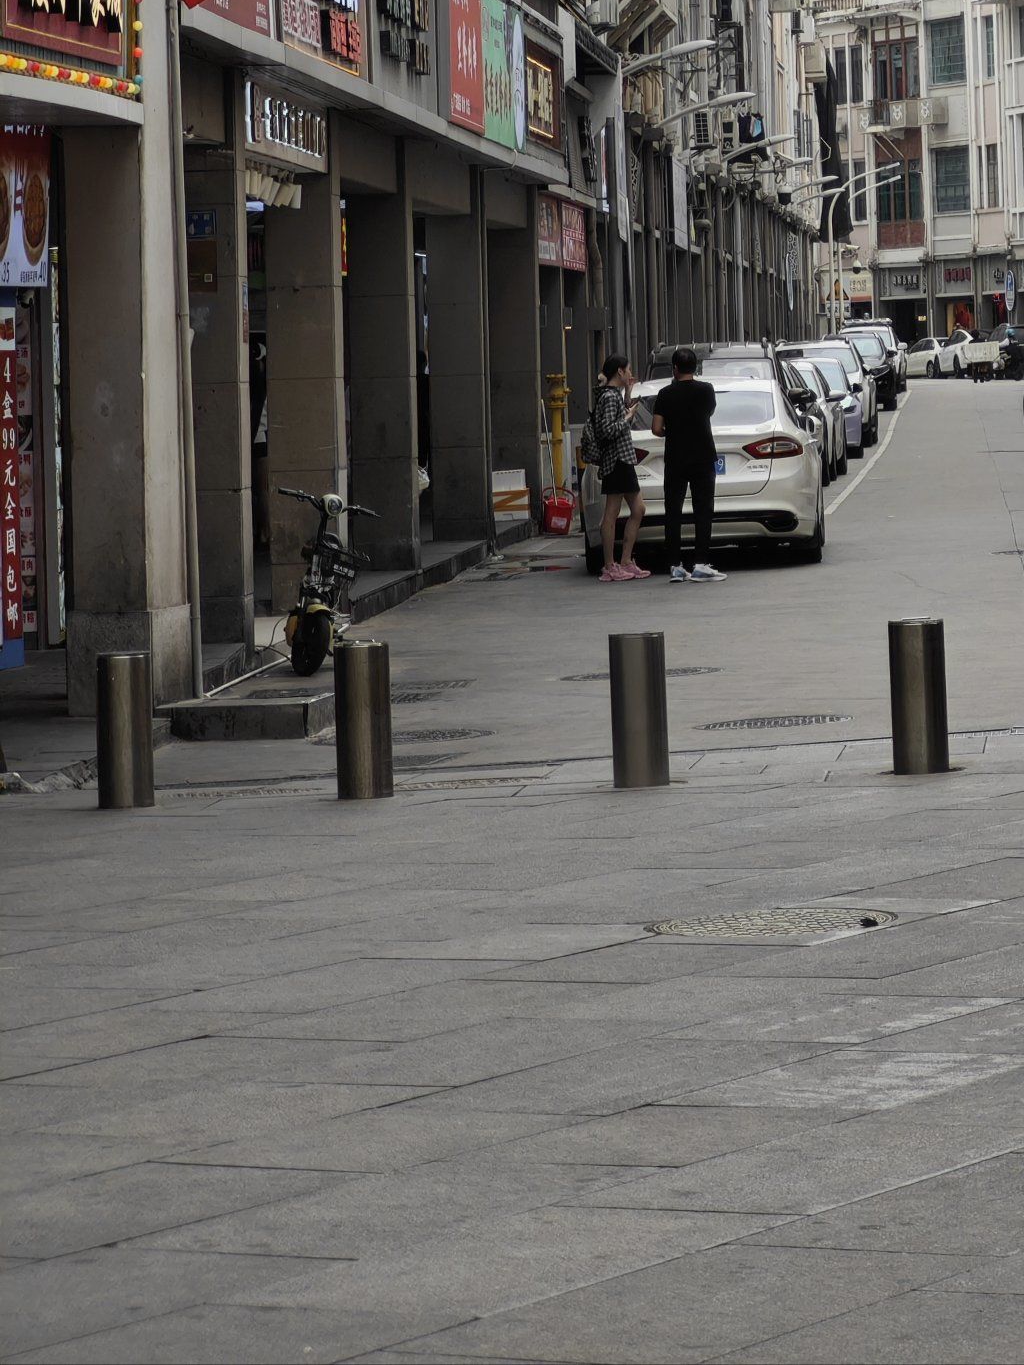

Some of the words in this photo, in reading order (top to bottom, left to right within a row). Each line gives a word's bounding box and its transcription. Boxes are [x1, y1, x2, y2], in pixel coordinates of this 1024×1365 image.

[2, 357, 18, 629] 4盒99元全国包邮
